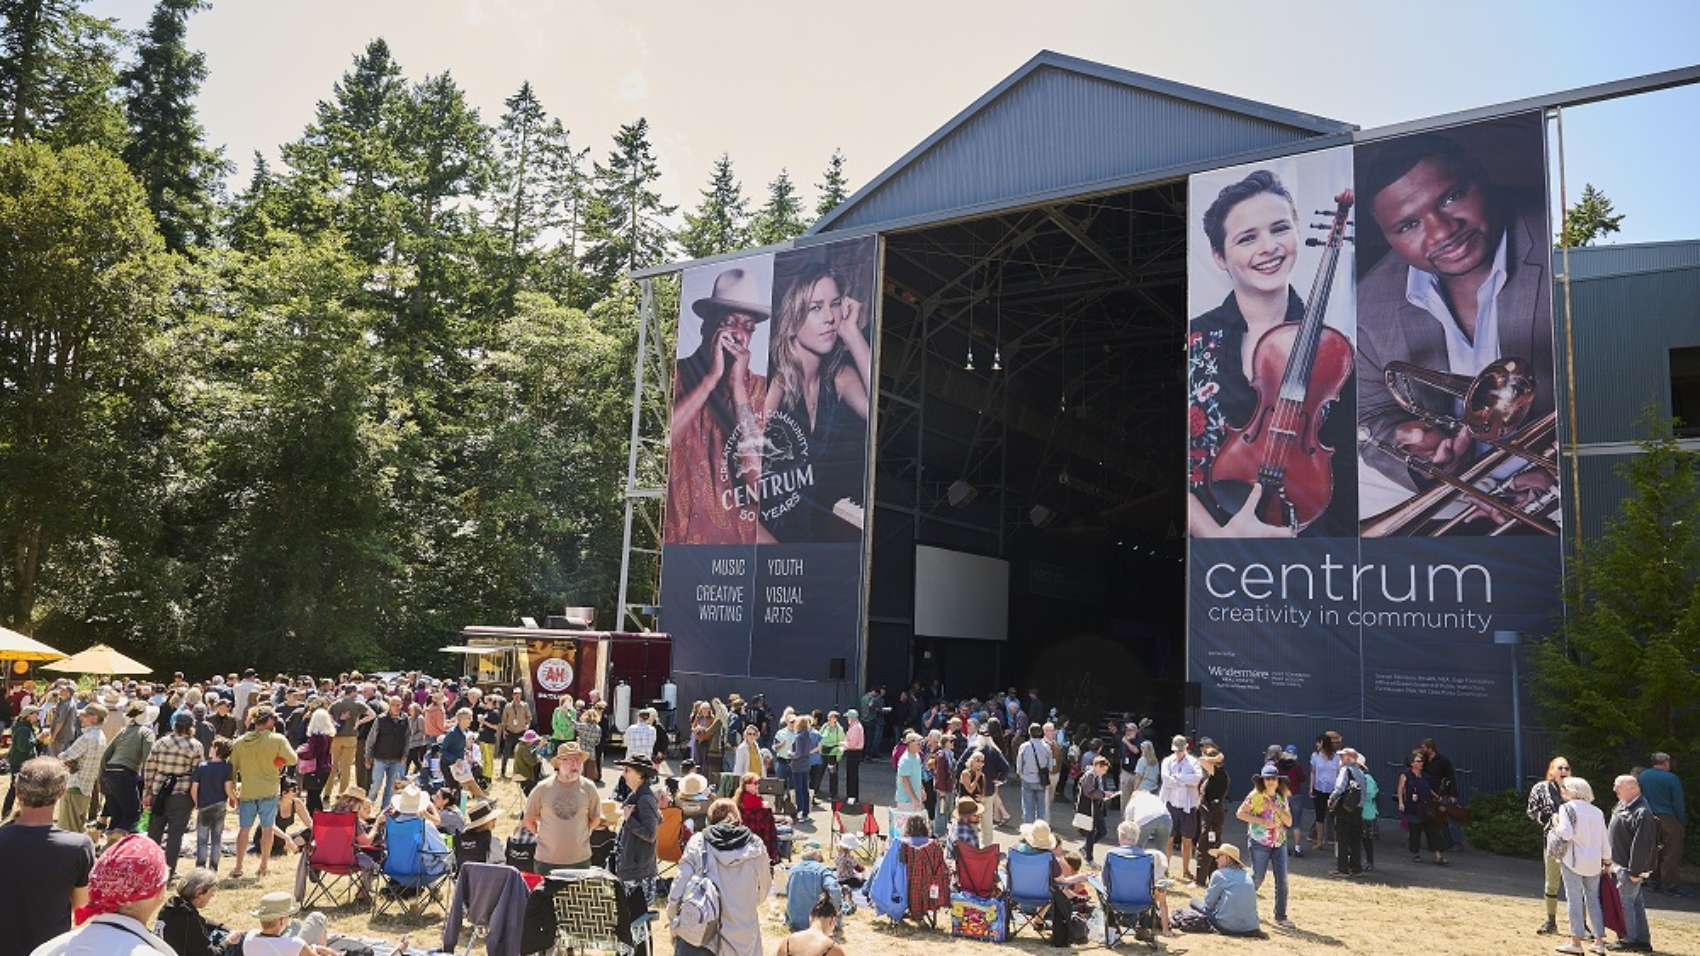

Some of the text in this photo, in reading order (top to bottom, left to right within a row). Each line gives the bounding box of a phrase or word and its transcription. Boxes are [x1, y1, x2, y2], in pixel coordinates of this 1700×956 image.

[766, 409, 809, 457] COMMUNITY
[721, 463, 814, 511] CENTRUM
[739, 491, 801, 522] 50 YEARS
[711, 558, 746, 576] MUSIC
[767, 558, 804, 576] YOUTH
[1204, 553, 1492, 603] centrum
[696, 584, 744, 603] CREATIVE
[765, 586, 803, 605] VISUAL
[698, 604, 743, 622] WRITING
[764, 606, 794, 624] ARTS
[1207, 603, 1493, 634] creativity in community
[1208, 665, 1269, 680] Windermere
